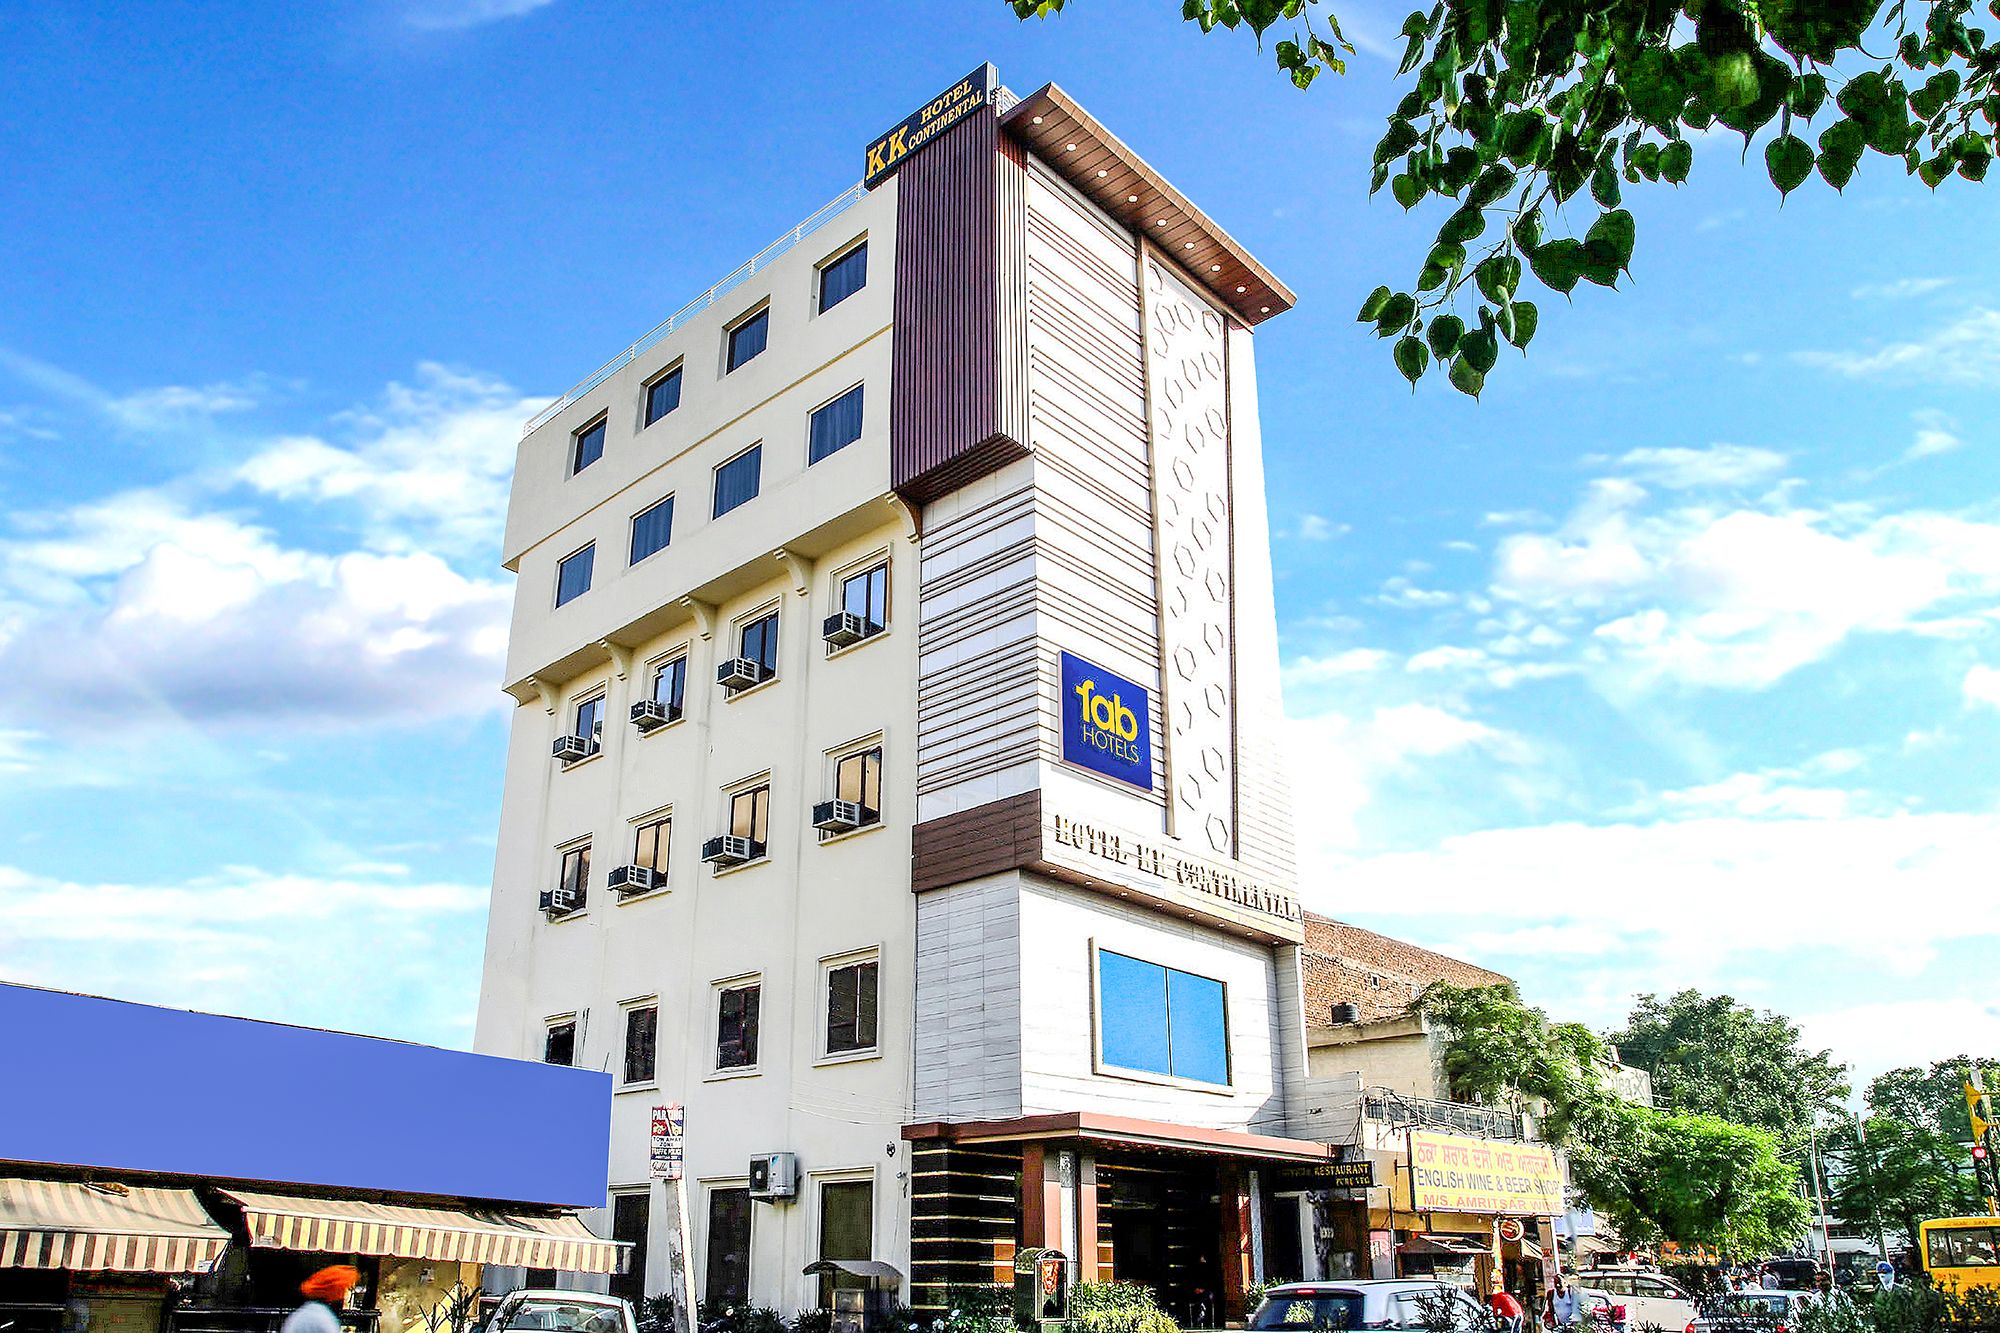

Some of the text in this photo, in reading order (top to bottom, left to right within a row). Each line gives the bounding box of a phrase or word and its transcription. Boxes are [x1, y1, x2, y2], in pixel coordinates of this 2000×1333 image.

[920, 80, 972, 125] HOTEL
[866, 90, 983, 180] KK CONTINENTAL
[1075, 679, 1138, 741] fab
[1083, 723, 1140, 763] HOTELS
[1054, 814, 1128, 865] HOTEL
[1176, 859, 1297, 922] CONTINENTAL
[1314, 1163, 1369, 1176] RESTAURANT
[1417, 1168, 1560, 1196] ENGLISH WINE & BEER SHOP
[1423, 1194, 1561, 1213] M/S. AMRITSAR WINE
